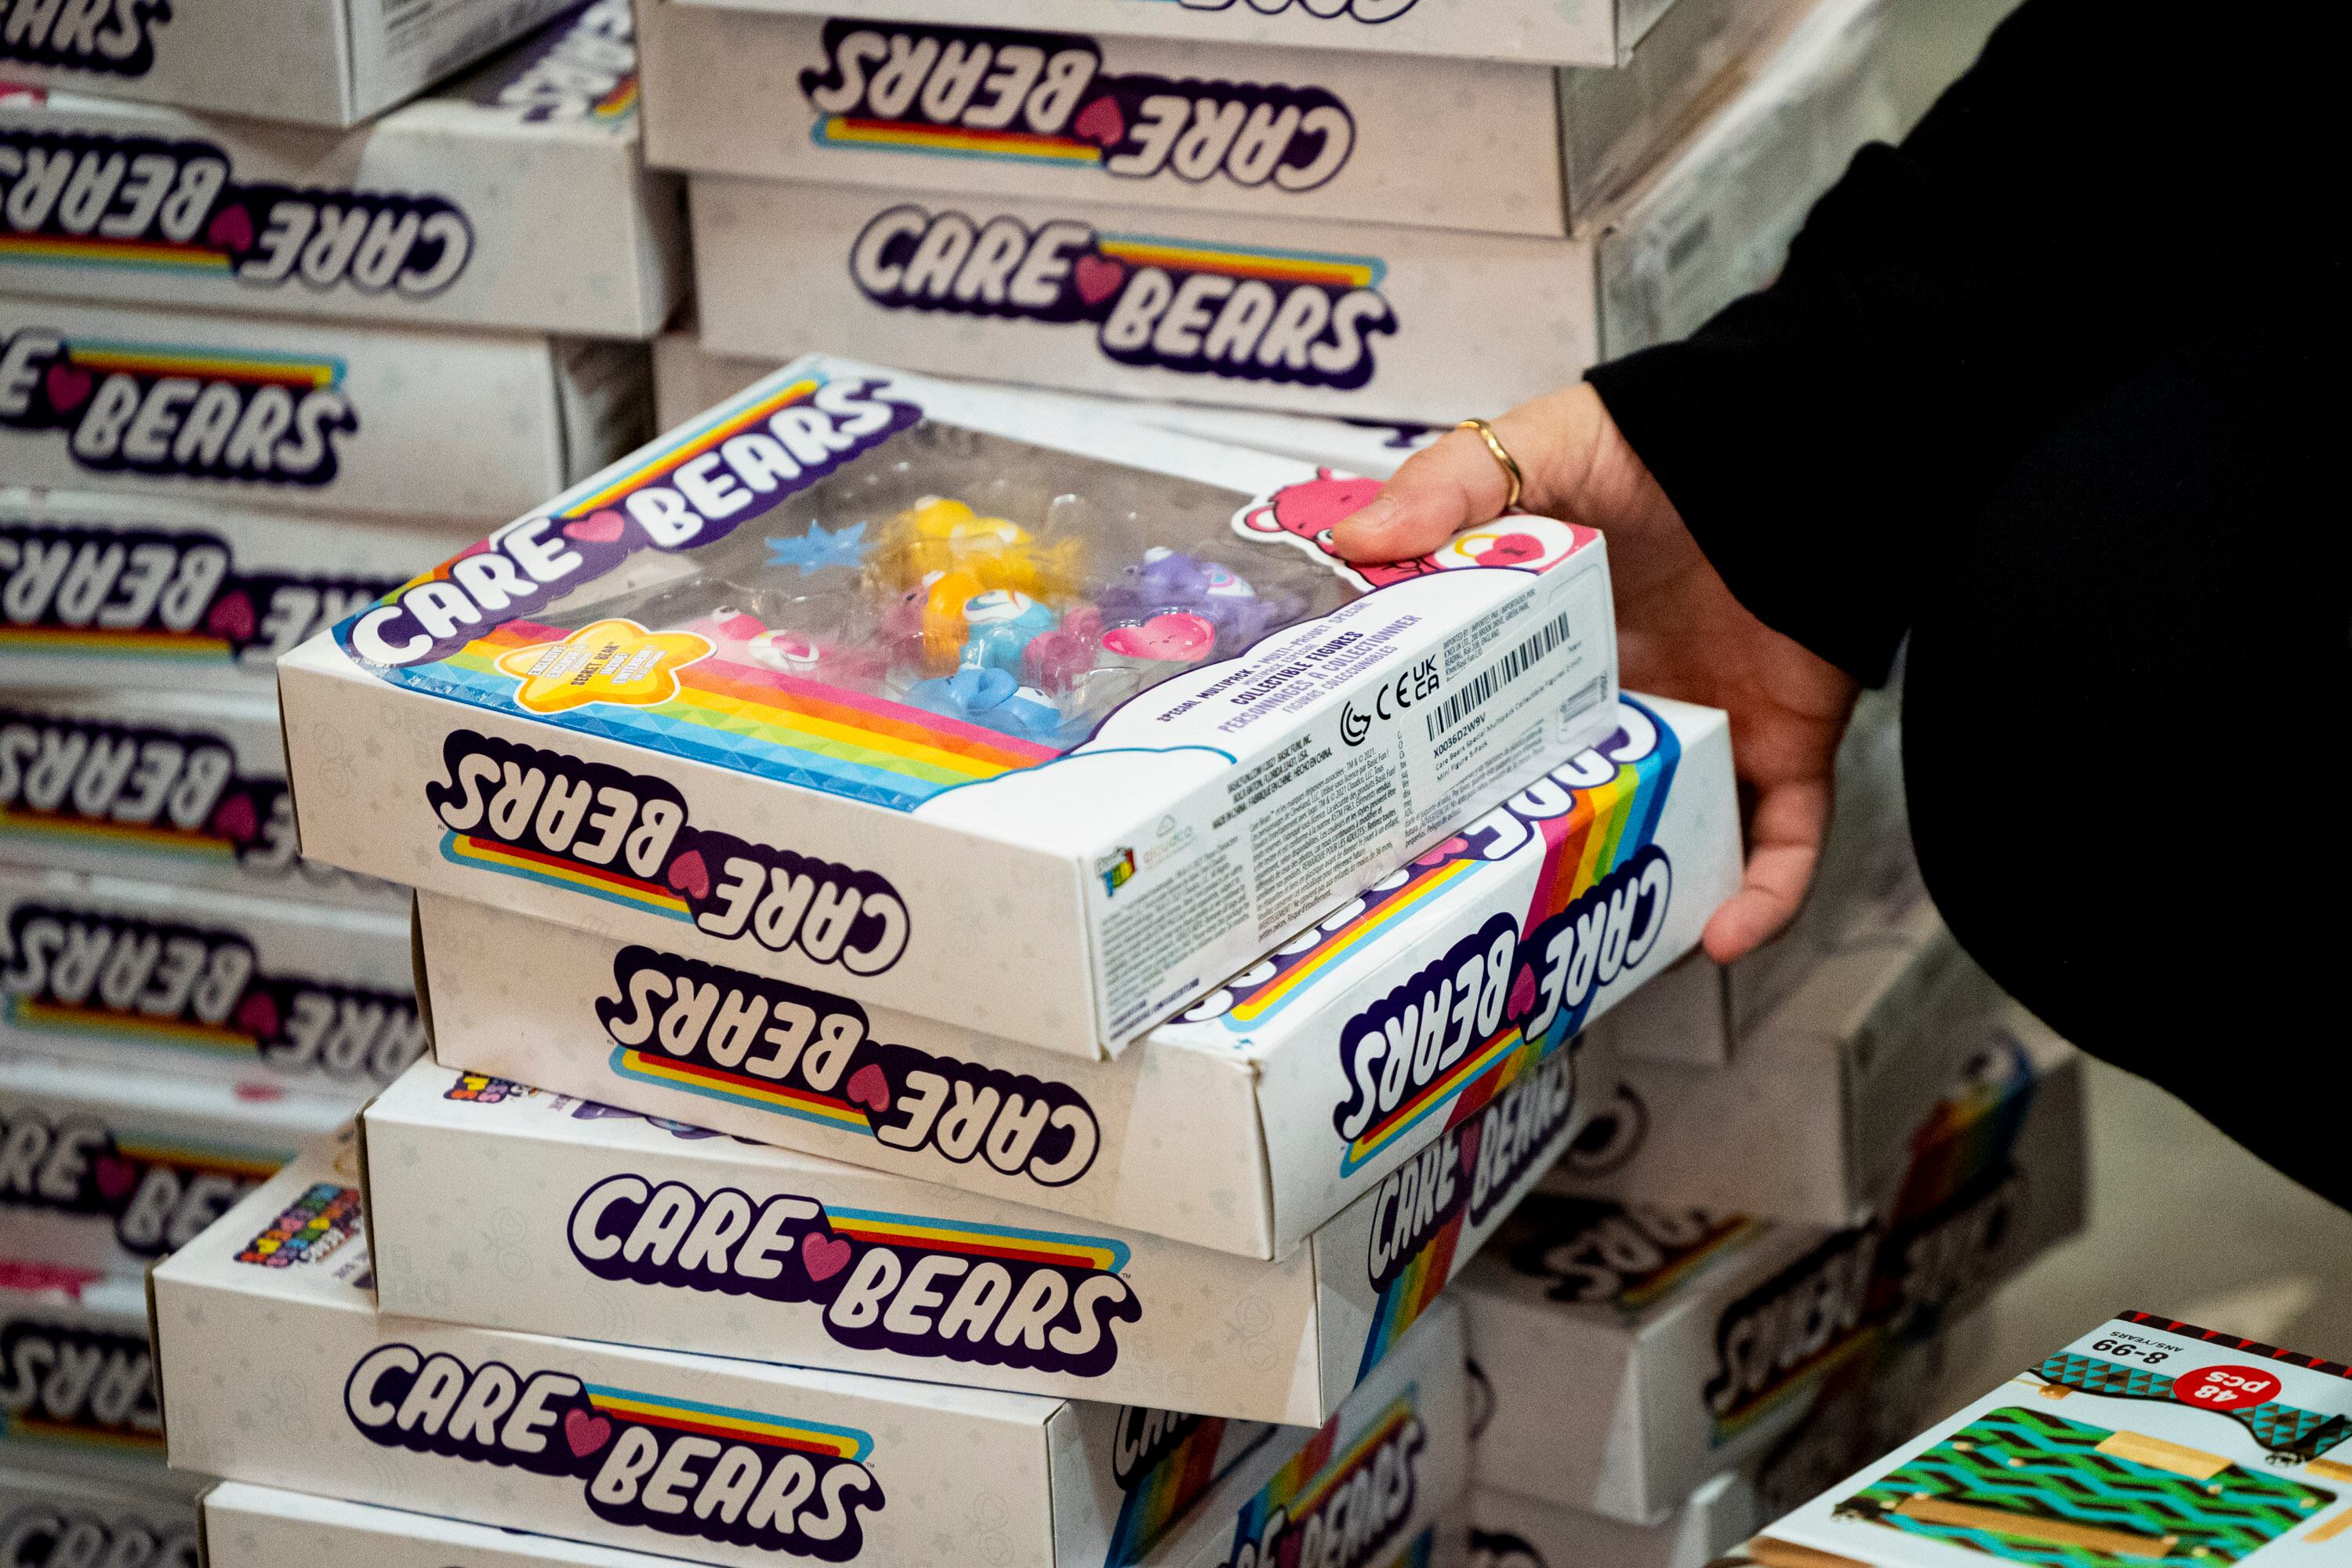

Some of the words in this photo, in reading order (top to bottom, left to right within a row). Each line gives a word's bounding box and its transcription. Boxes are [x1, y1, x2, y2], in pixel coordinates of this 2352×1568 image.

[812, 31, 1095, 132] BEARS
[1110, 94, 1350, 191] CARE
[242, 202, 470, 292] CARE
[857, 209, 1090, 305] CARE
[1102, 267, 1391, 375] BEARS
[75, 373, 347, 470] BEARS
[350, 515, 583, 665] CARE
[626, 379, 906, 548] BEARS
[1196, 669, 1255, 699] MULTIPACK
[1218, 679, 1314, 733] PERSONNAGES
[1321, 615, 1423, 672] COLLECTIONNER
[1231, 660, 1313, 705] COLLECTIBLE
[1305, 630, 1364, 661] FIGURES
[1283, 689, 1325, 713] FIGURAS
[1321, 645, 1398, 690] COLECCIONABLES
[1413, 653, 1438, 682] UK
[1415, 673, 1440, 700] CA
[1433, 711, 1486, 759] X0036D2W9V
[1436, 756, 1447, 771] Care
[1450, 743, 1465, 760] Bears
[1466, 728, 1485, 748] Special
[1486, 706, 1513, 733] Multipack
[1437, 768, 1449, 782] Mini
[1451, 754, 1468, 773] Figure
[439, 753, 686, 879] BEARS
[698, 858, 908, 971] CARE
[1525, 850, 1671, 1043] CARE
[10, 919, 252, 1023] BEARS
[609, 969, 865, 1094] BEARS
[1341, 929, 1515, 1141] BEARS
[879, 1069, 1095, 1181] CARE
[572, 1178, 820, 1281] CARE
[829, 1247, 1141, 1358] BEARS
[2092, 1338, 2169, 1364] 8-99
[2110, 1330, 2184, 1352] ANS/YEARS
[2205, 1370, 2271, 1393] pcs
[2194, 1385, 2239, 1403] 48
[350, 1348, 583, 1453] CARE
[591, 1424, 885, 1542] BEARS
